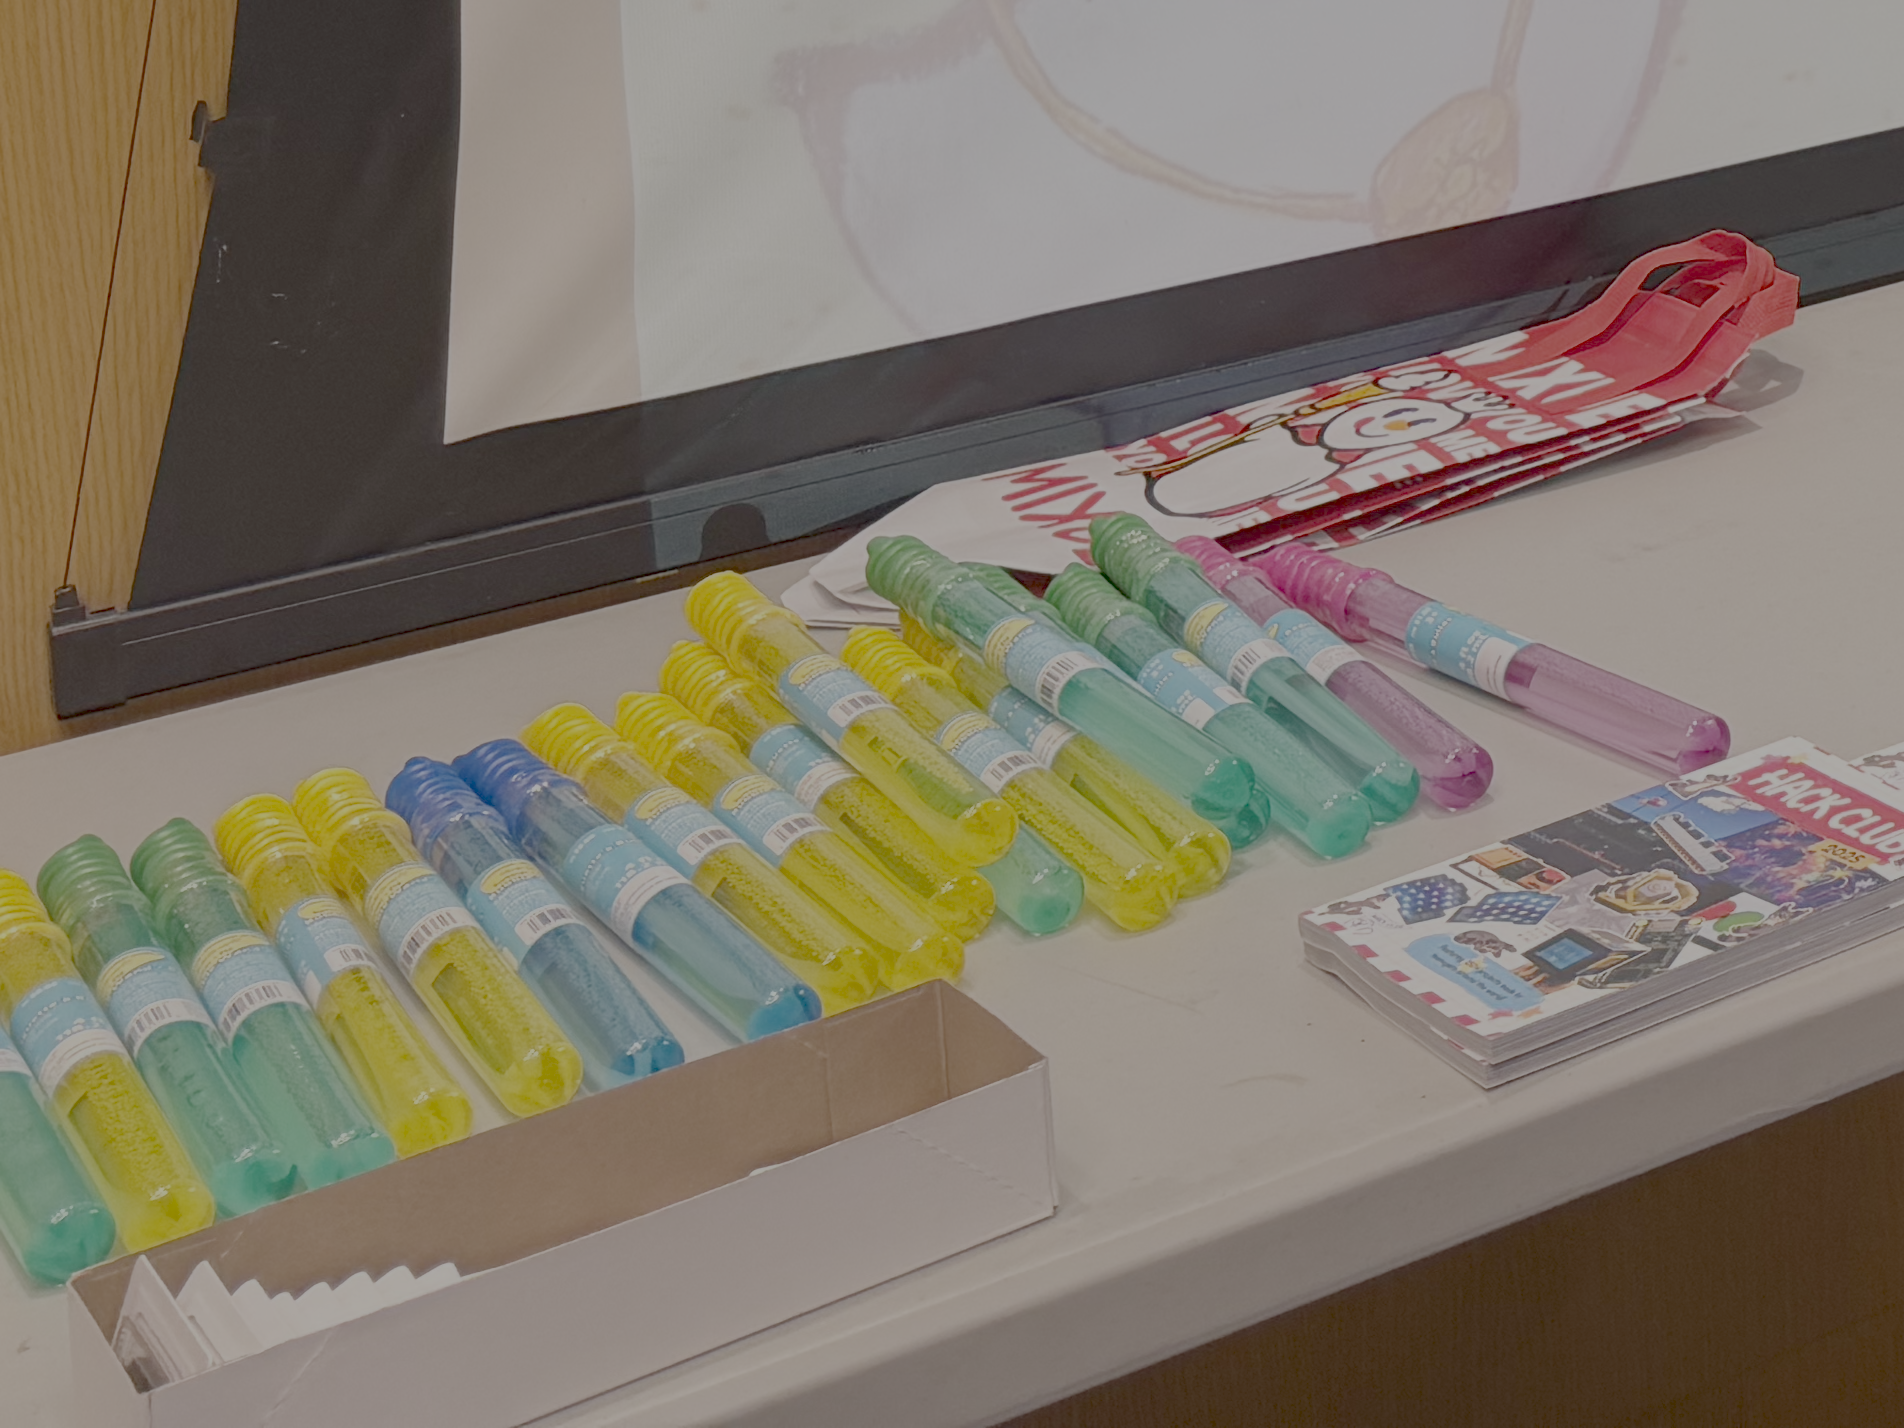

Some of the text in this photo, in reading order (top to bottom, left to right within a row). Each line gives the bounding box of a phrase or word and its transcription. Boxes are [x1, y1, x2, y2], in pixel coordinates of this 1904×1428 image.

[981, 463, 1115, 566] MIX
[1748, 769, 1852, 819] HACK
[1821, 844, 1866, 864] 2025
